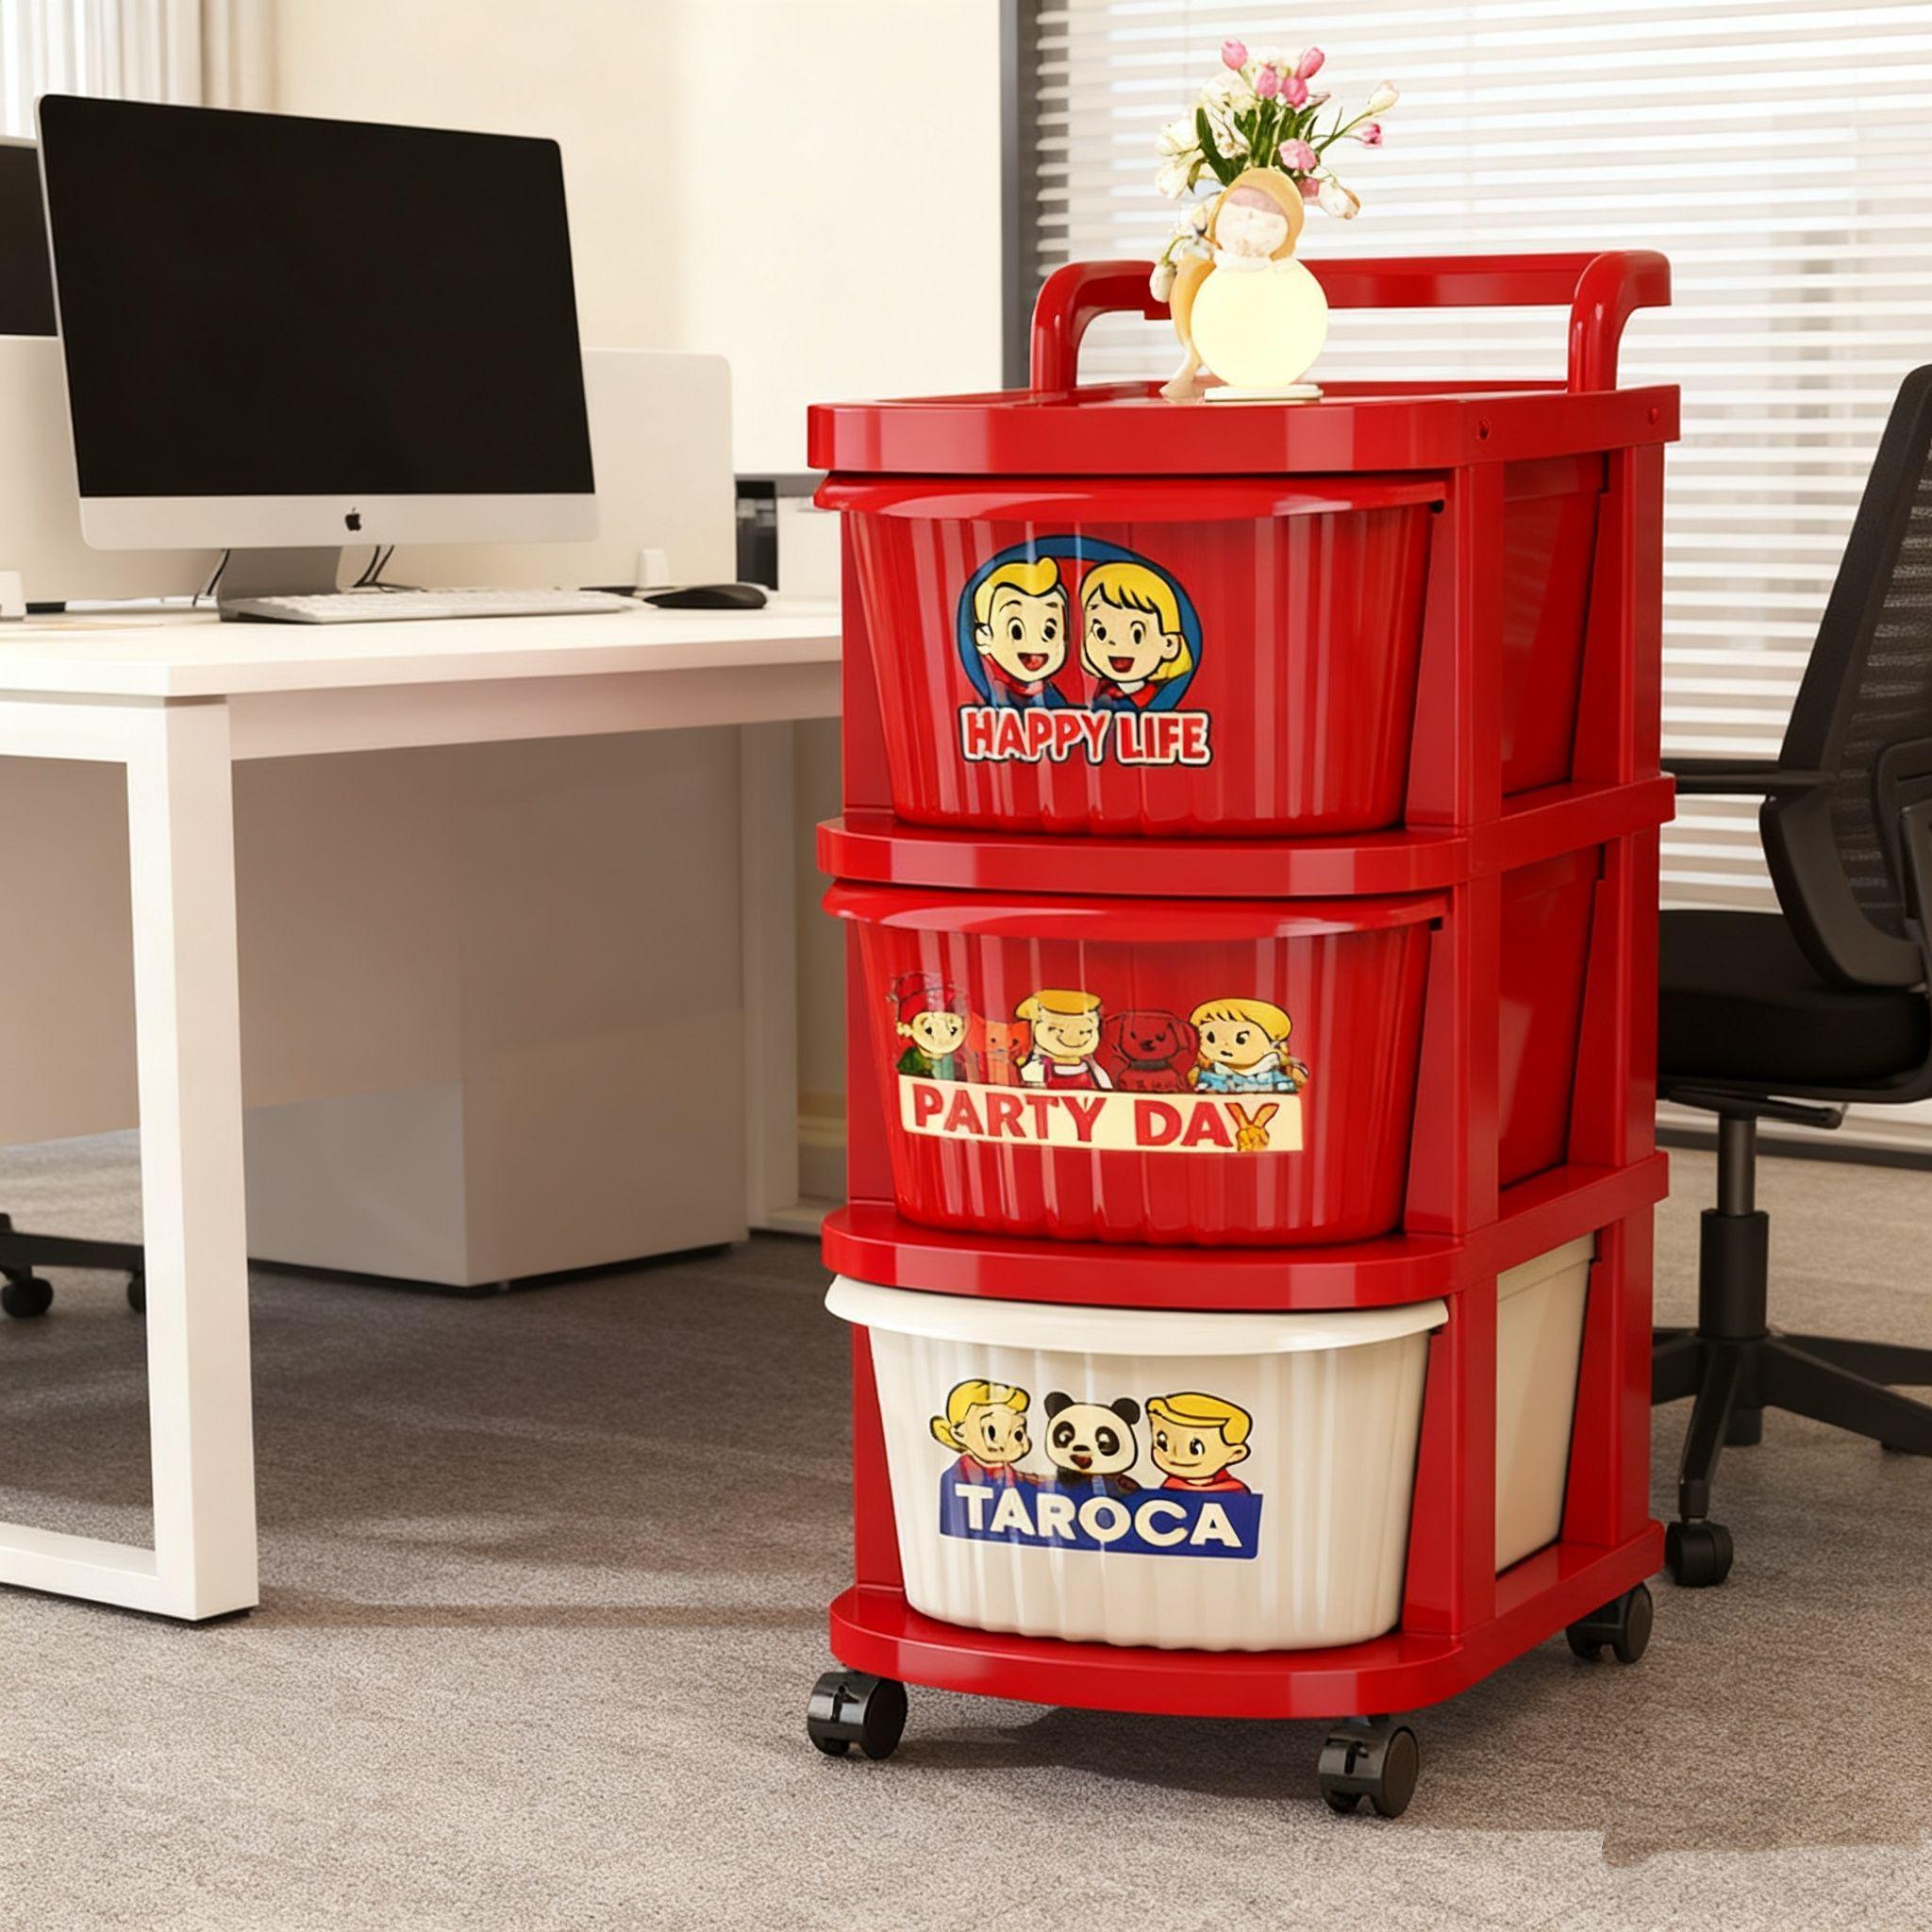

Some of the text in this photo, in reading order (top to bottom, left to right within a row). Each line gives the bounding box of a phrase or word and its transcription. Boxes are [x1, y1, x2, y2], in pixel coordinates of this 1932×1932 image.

[962, 708, 1210, 764] HAPPY LIFE
[913, 1084, 1280, 1152] PARTY DAY
[955, 1483, 1242, 1547] TAROCA
